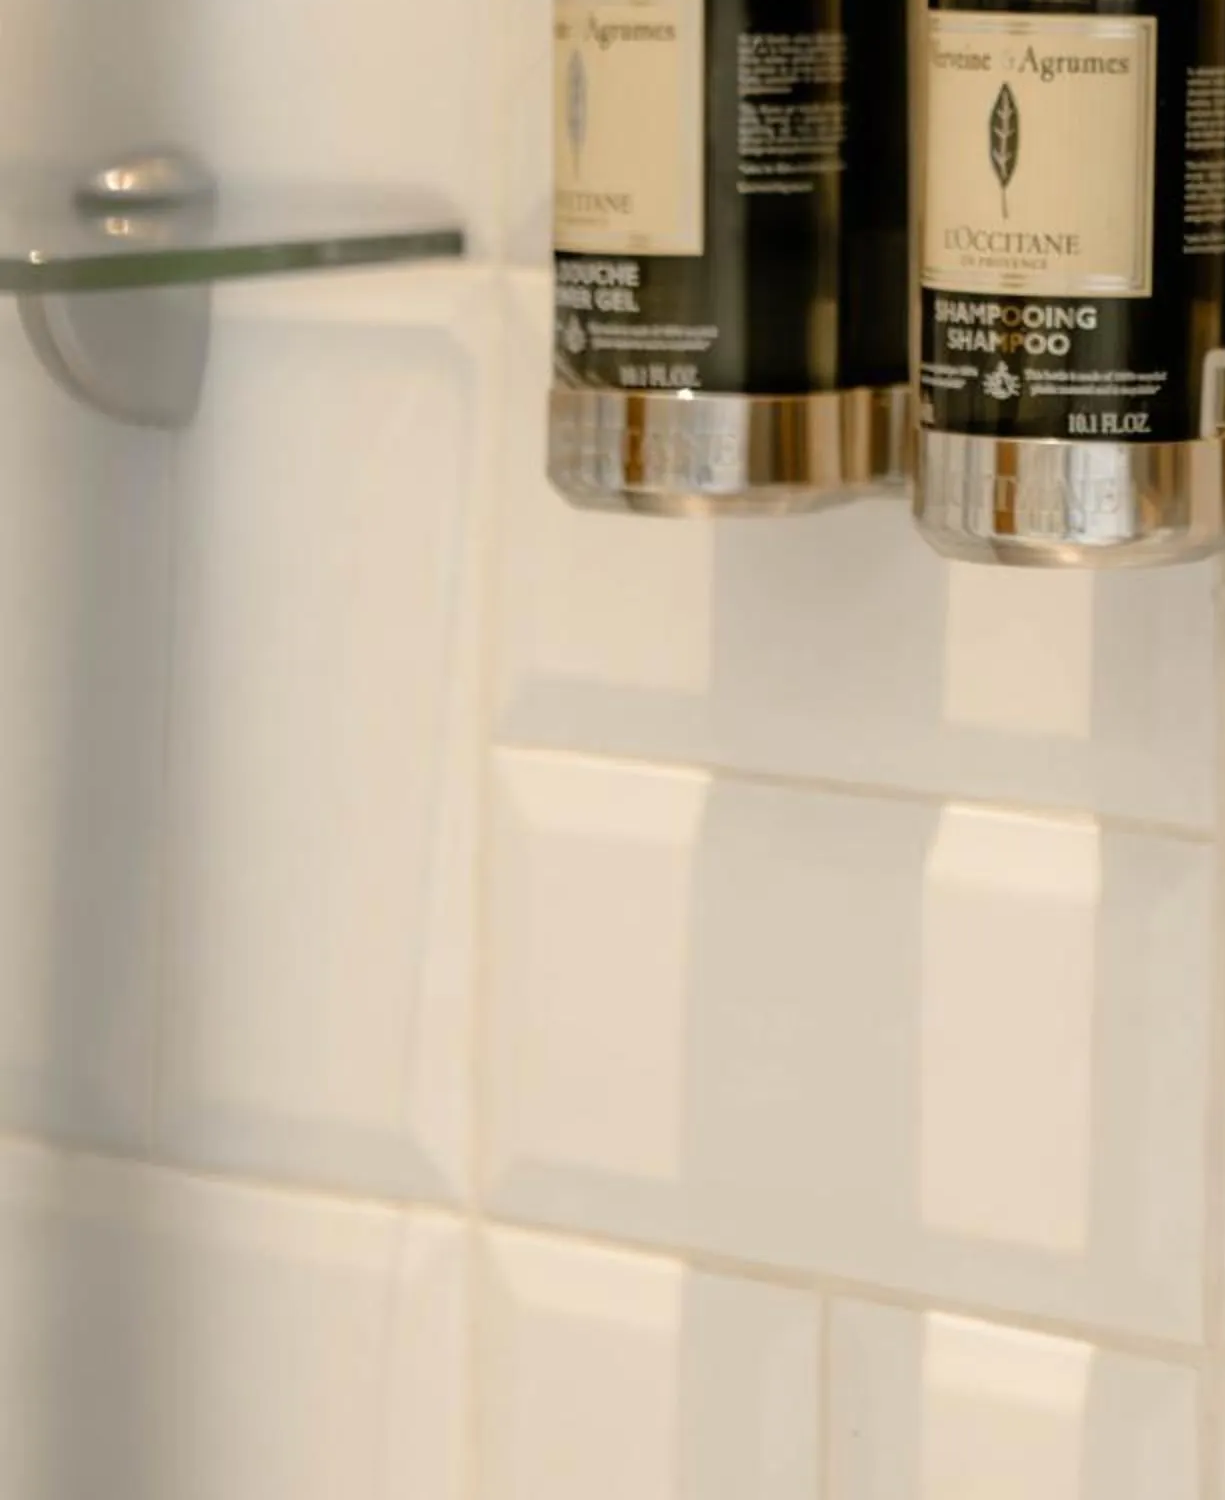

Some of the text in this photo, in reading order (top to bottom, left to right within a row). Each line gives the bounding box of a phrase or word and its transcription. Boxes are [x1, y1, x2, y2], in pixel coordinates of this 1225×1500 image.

[1018, 45, 1131, 82] Agrumes
[934, 300, 1097, 330] SHAMPOOING
[946, 327, 1070, 356] SHAMPOO
